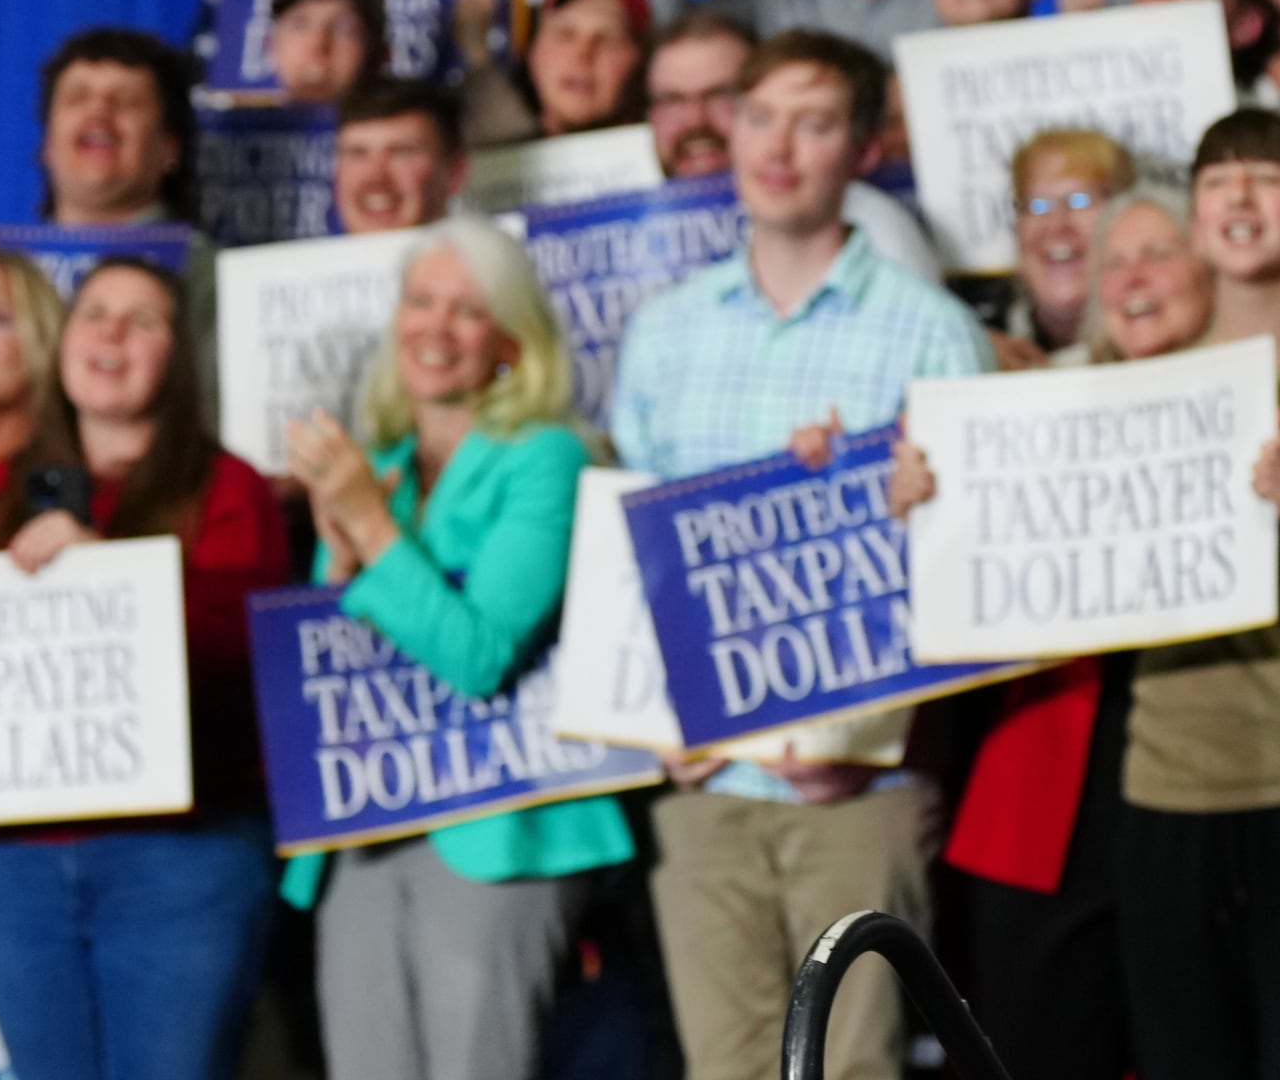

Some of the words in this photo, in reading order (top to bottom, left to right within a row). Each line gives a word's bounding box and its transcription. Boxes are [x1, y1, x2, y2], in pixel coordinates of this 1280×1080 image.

[964, 387, 1236, 470] PROTECTING
[674, 461, 892, 569] PROTECT
[966, 454, 1236, 548] TAXPAYER
[686, 526, 908, 637] TAXPAY
[971, 528, 1239, 626] DOLLARS
